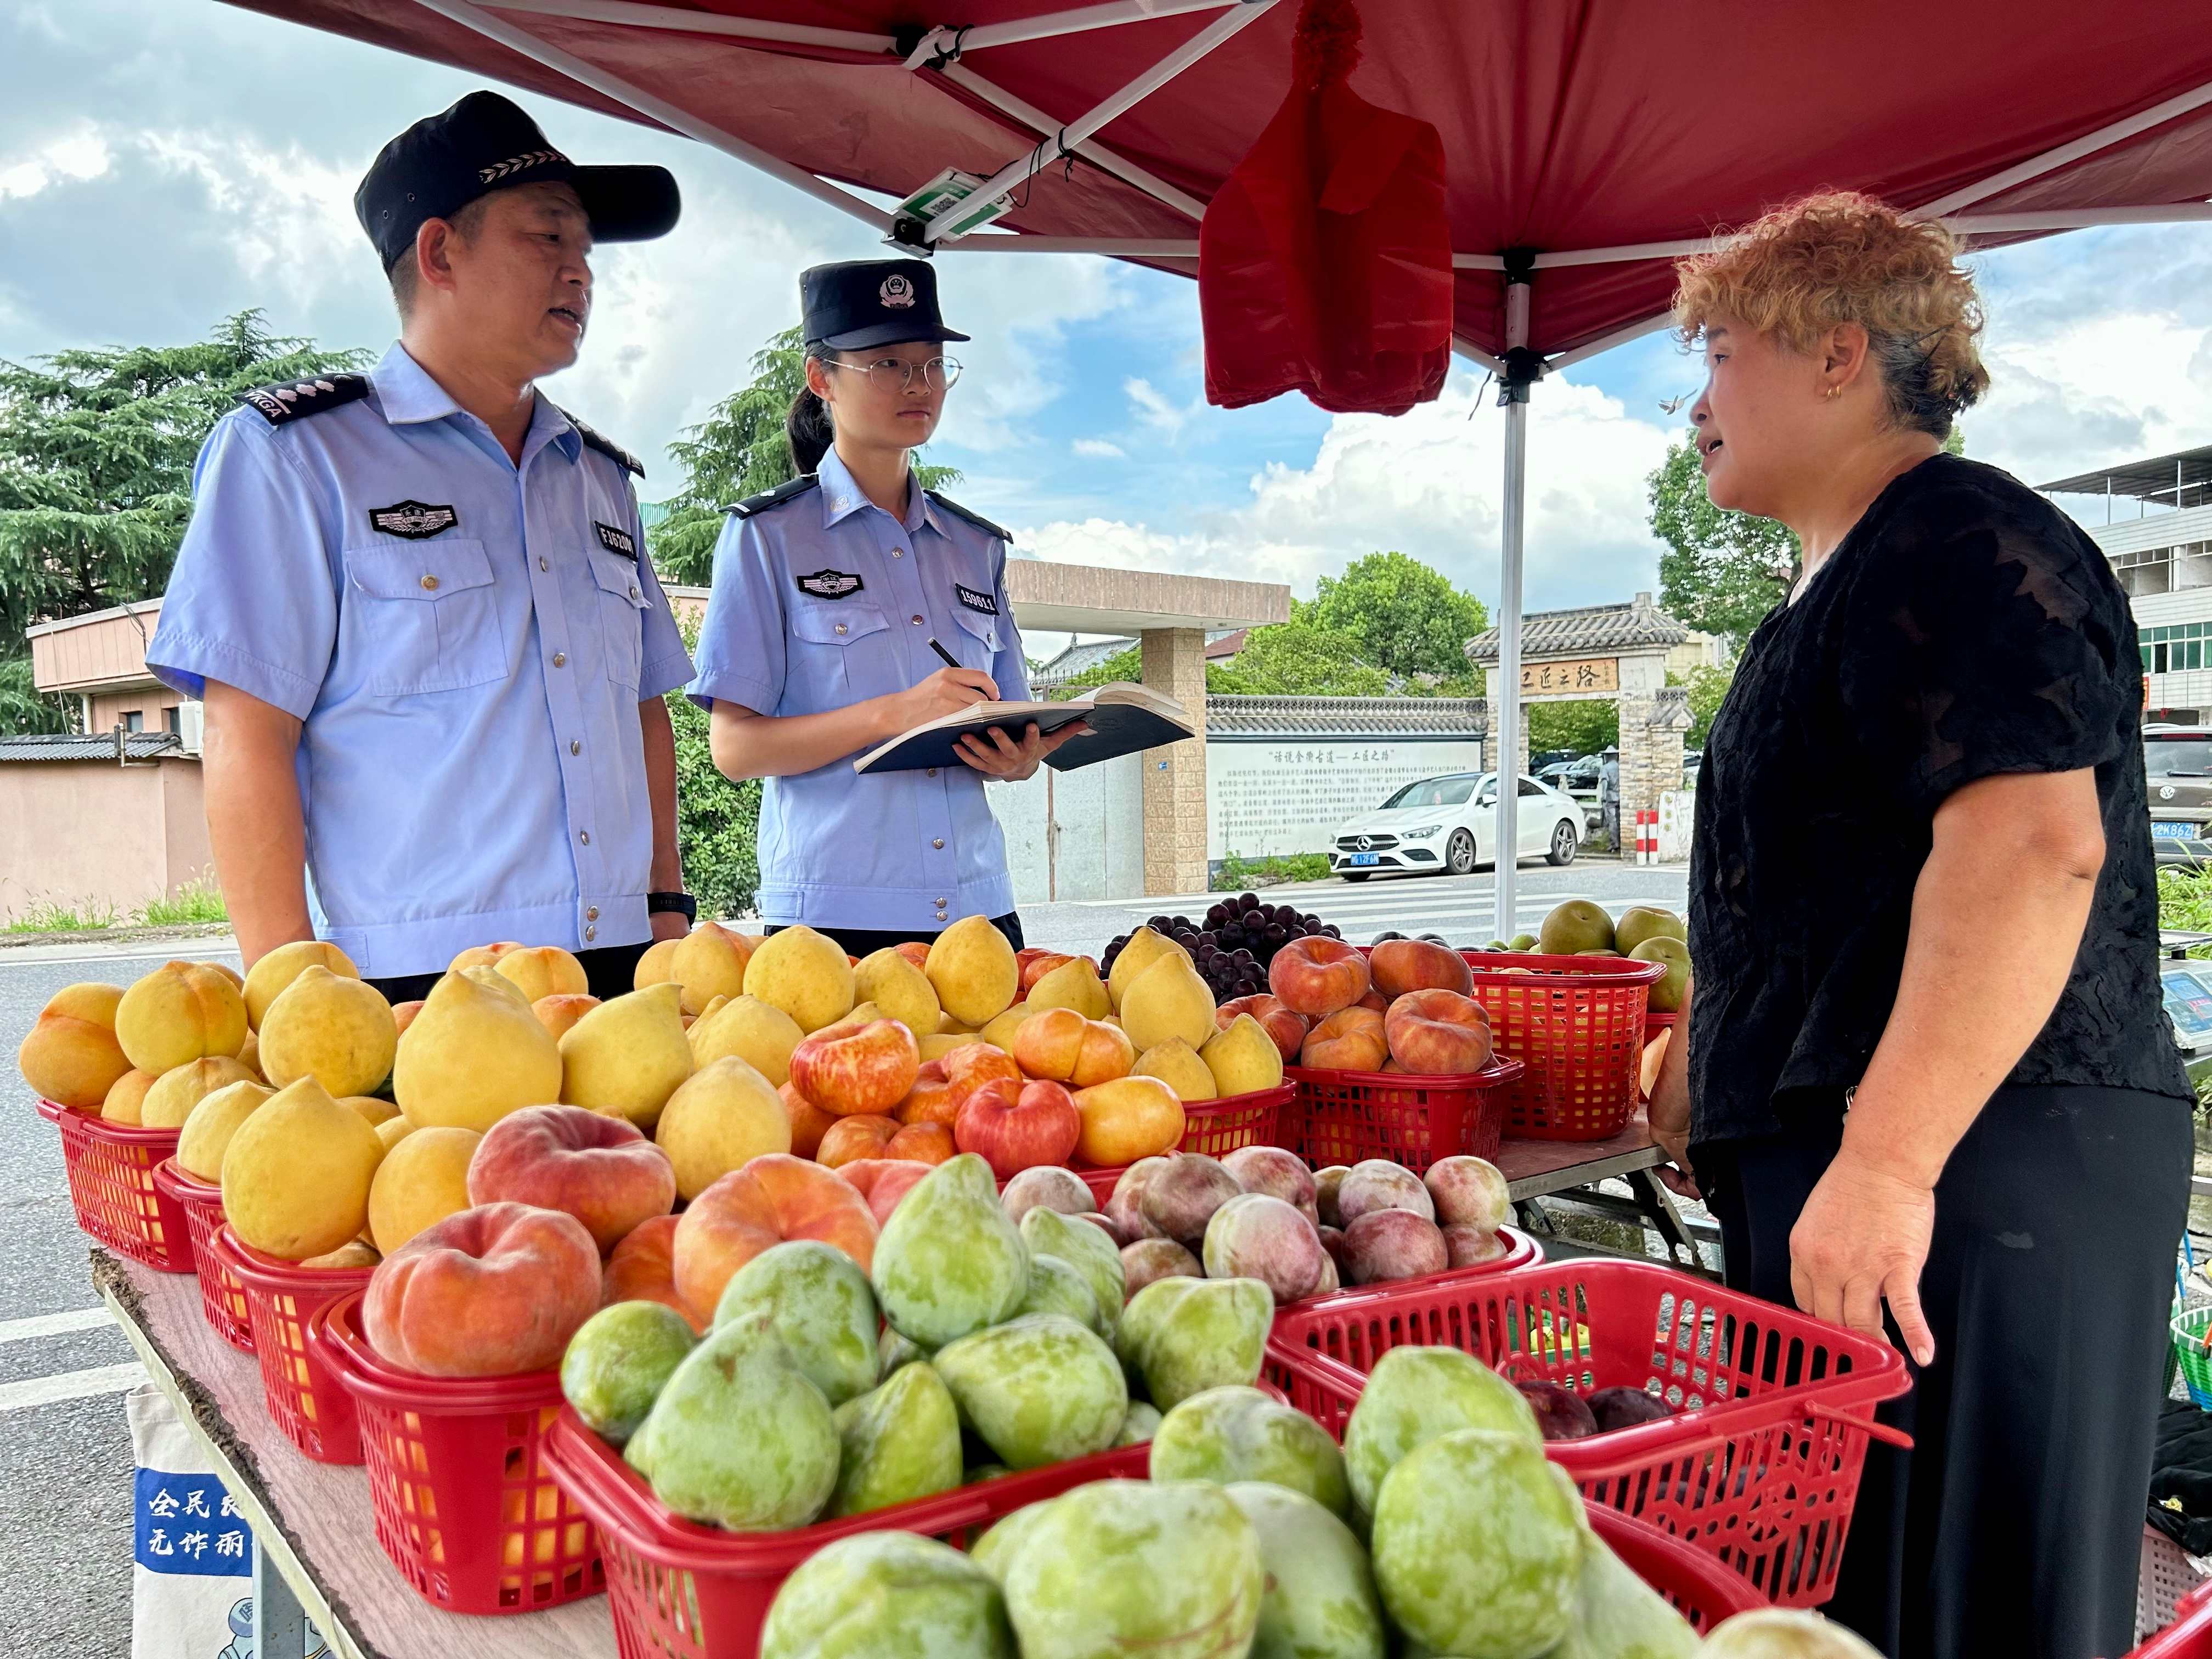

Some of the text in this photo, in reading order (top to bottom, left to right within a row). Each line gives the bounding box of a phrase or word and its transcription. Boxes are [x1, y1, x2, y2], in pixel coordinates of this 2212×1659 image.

[244, 391, 283, 417] YKGA
[961, 589, 995, 611] 159611
[149, 1528, 253, 1560] 无诈丽
